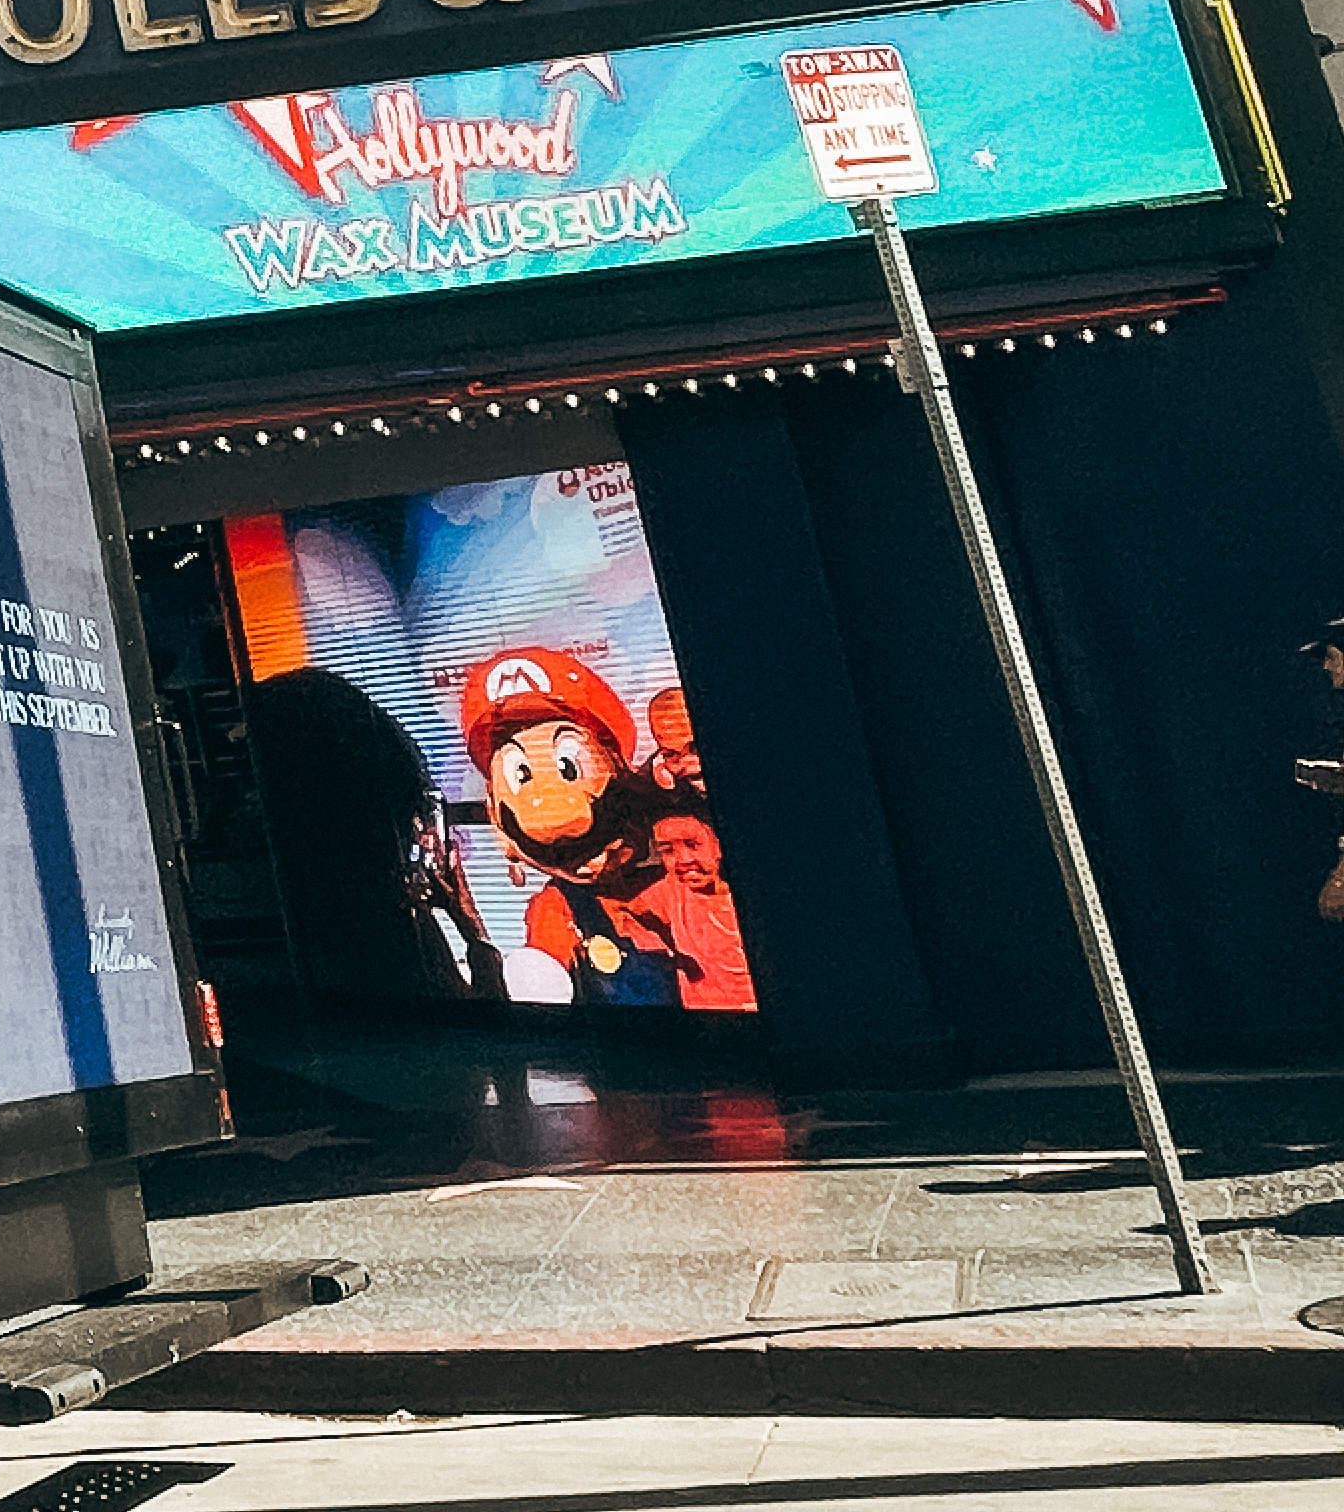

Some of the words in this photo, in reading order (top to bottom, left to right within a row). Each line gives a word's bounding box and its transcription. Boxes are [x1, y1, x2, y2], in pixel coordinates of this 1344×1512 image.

[787, 49, 892, 76] TOW-AWAY
[792, 82, 834, 122] NO
[833, 82, 906, 112] STOPPING
[312, 88, 575, 218] Hollywood
[823, 126, 858, 152] ANY
[867, 122, 911, 149] TIME
[1, 599, 34, 637] FOR
